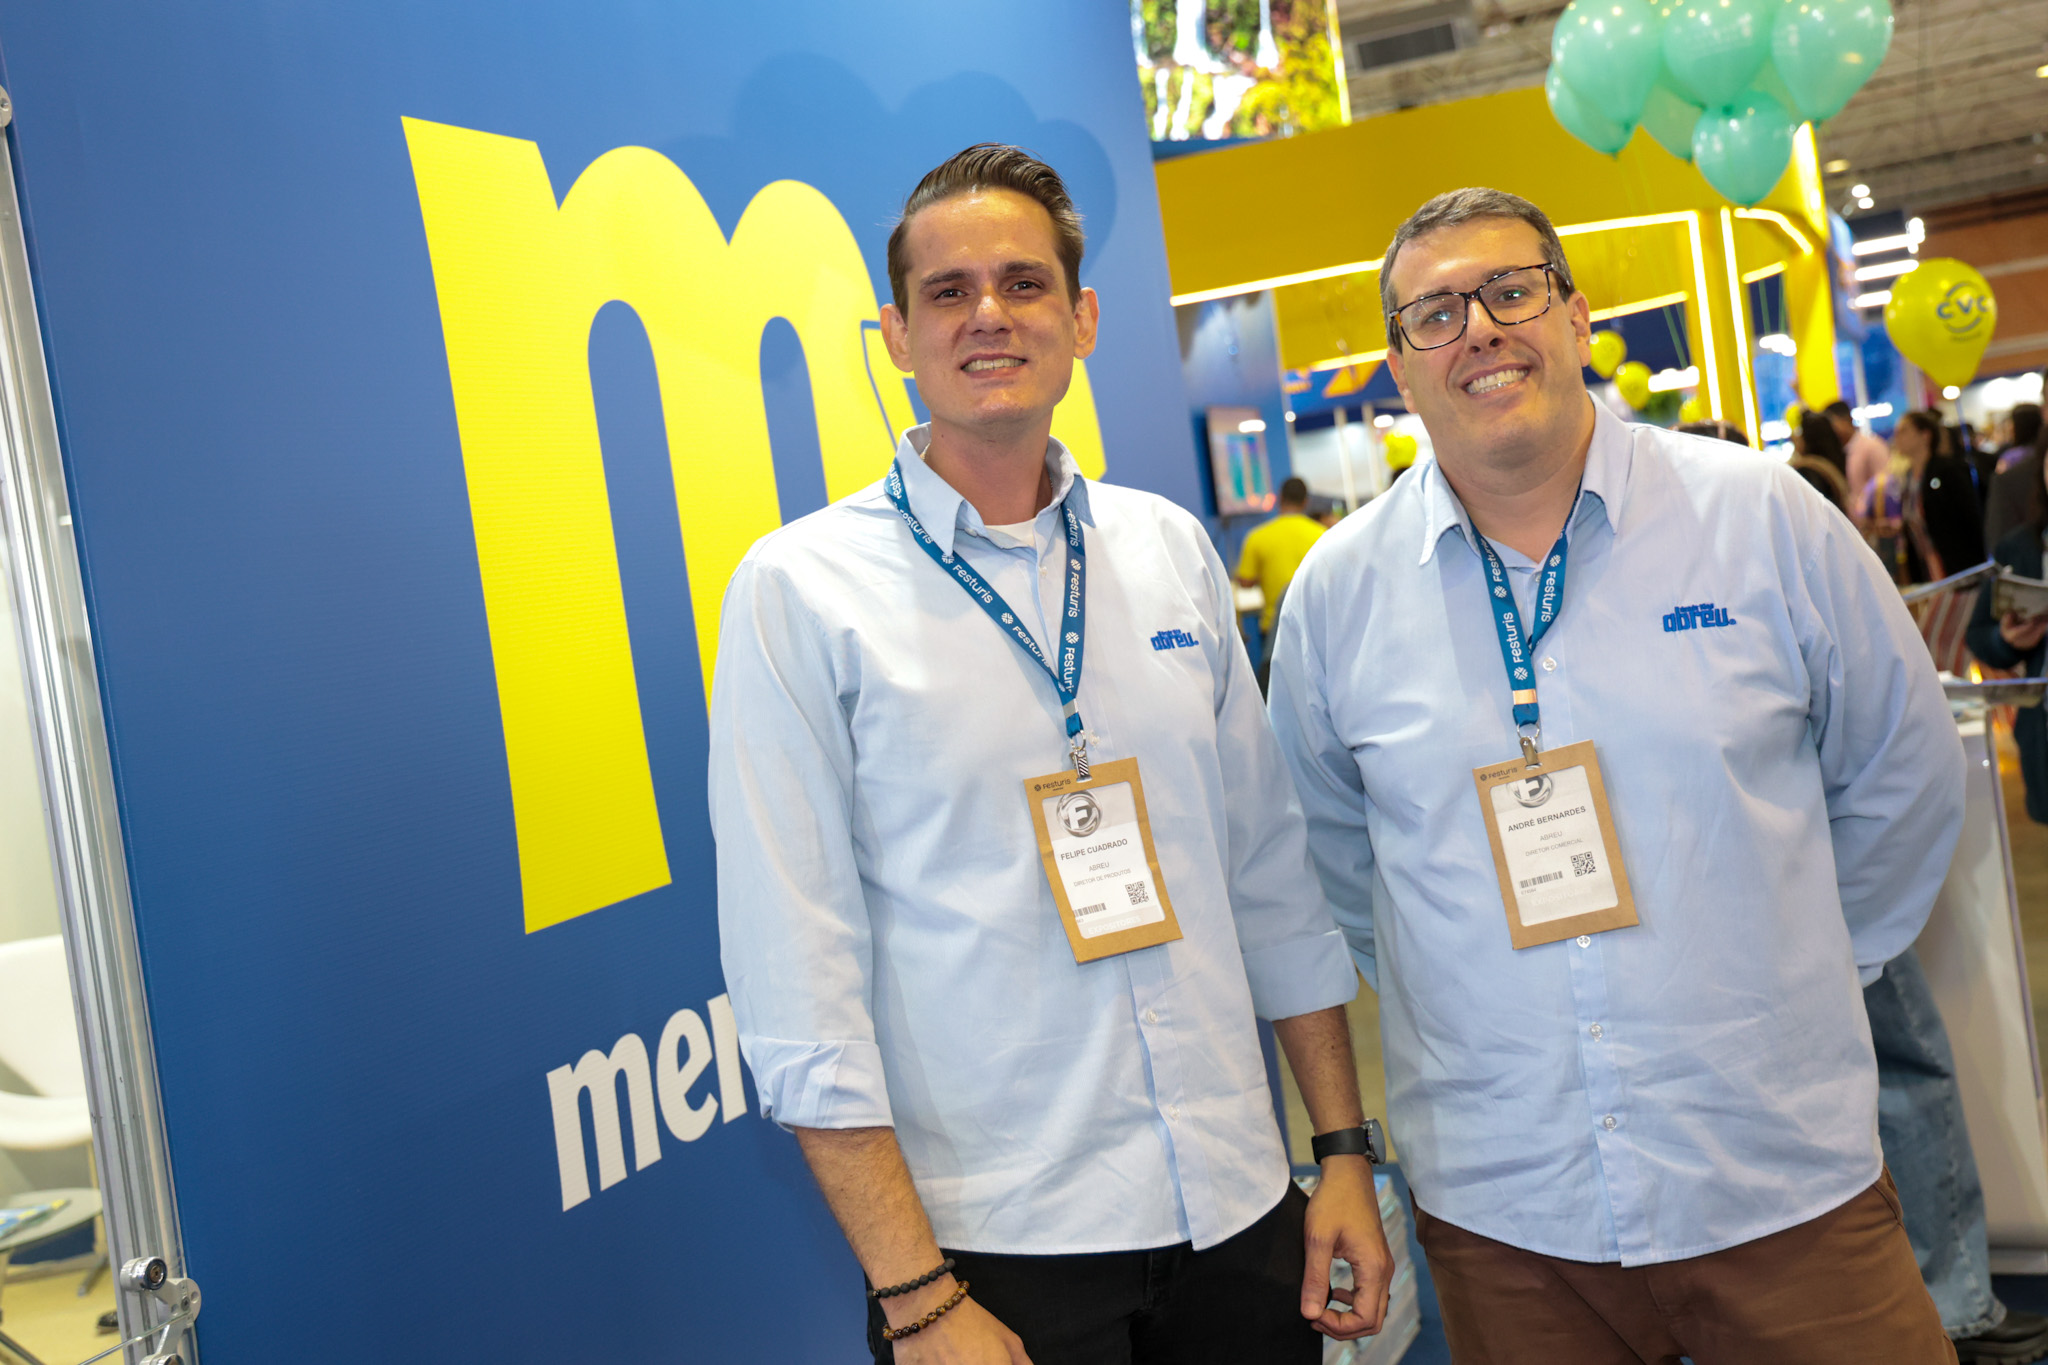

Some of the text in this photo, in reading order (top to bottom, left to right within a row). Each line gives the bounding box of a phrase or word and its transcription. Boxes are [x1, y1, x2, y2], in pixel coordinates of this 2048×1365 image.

[953, 564, 993, 604] Festuris
[1067, 571, 1081, 618] Festuris
[1541, 571, 1557, 623] Festuris
[1502, 612, 1524, 663] Festuris
[1508, 805, 1586, 832] ANDRÉ BERNARDES
[1525, 838, 1583, 857] DIRETOR COMERCIAL
[1540, 831, 1563, 841] ABREU
[1060, 838, 1128, 861] FELIPE CUADRADO
[1073, 876, 1096, 887] DIRETOR
[1104, 868, 1132, 880] PRODUTOS
[1088, 862, 1110, 872] ABREU
